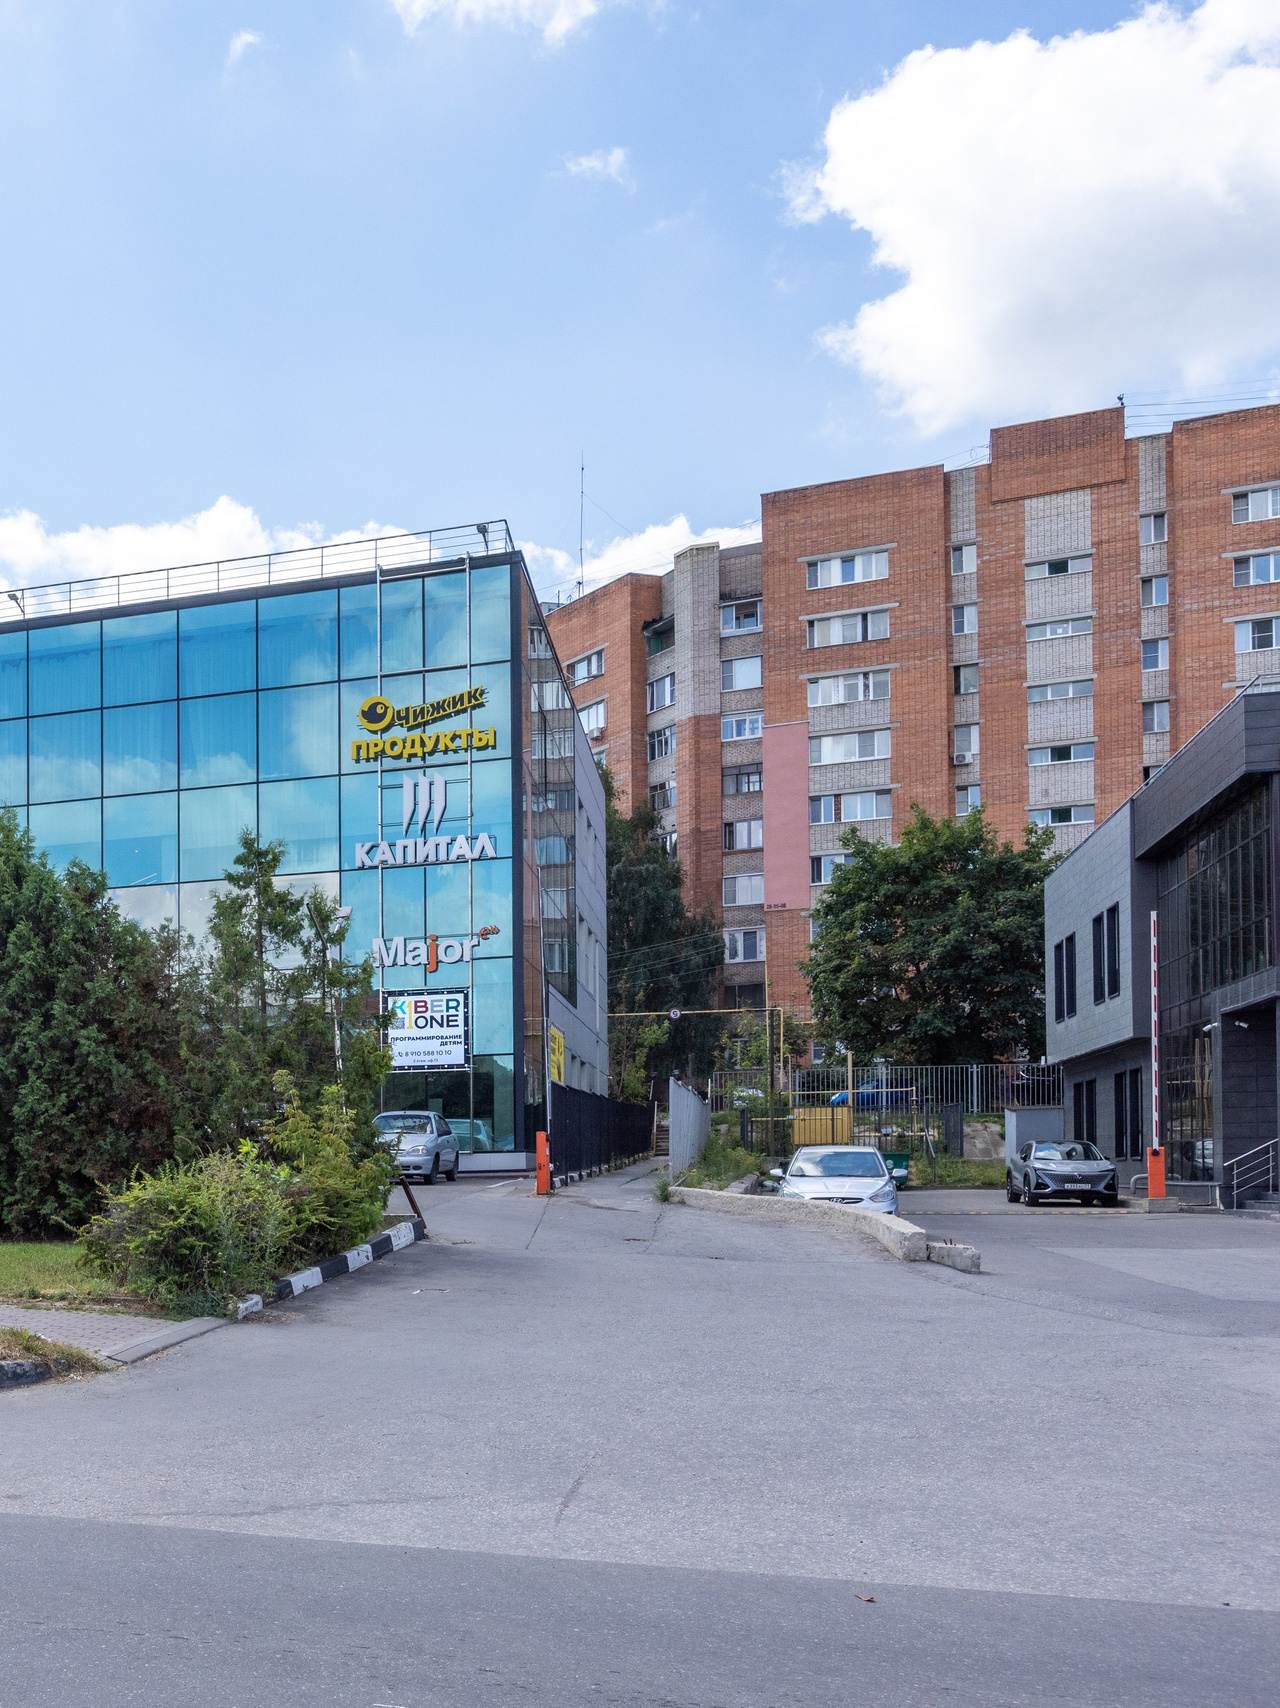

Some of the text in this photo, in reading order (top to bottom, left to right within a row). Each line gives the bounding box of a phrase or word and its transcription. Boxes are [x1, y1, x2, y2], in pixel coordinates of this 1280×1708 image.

[351, 726, 495, 760] ПРОДУКТЫ
[355, 832, 497, 867] КАПИТАЛ
[372, 934, 480, 973] Major
[414, 1014, 459, 1029] ONE
